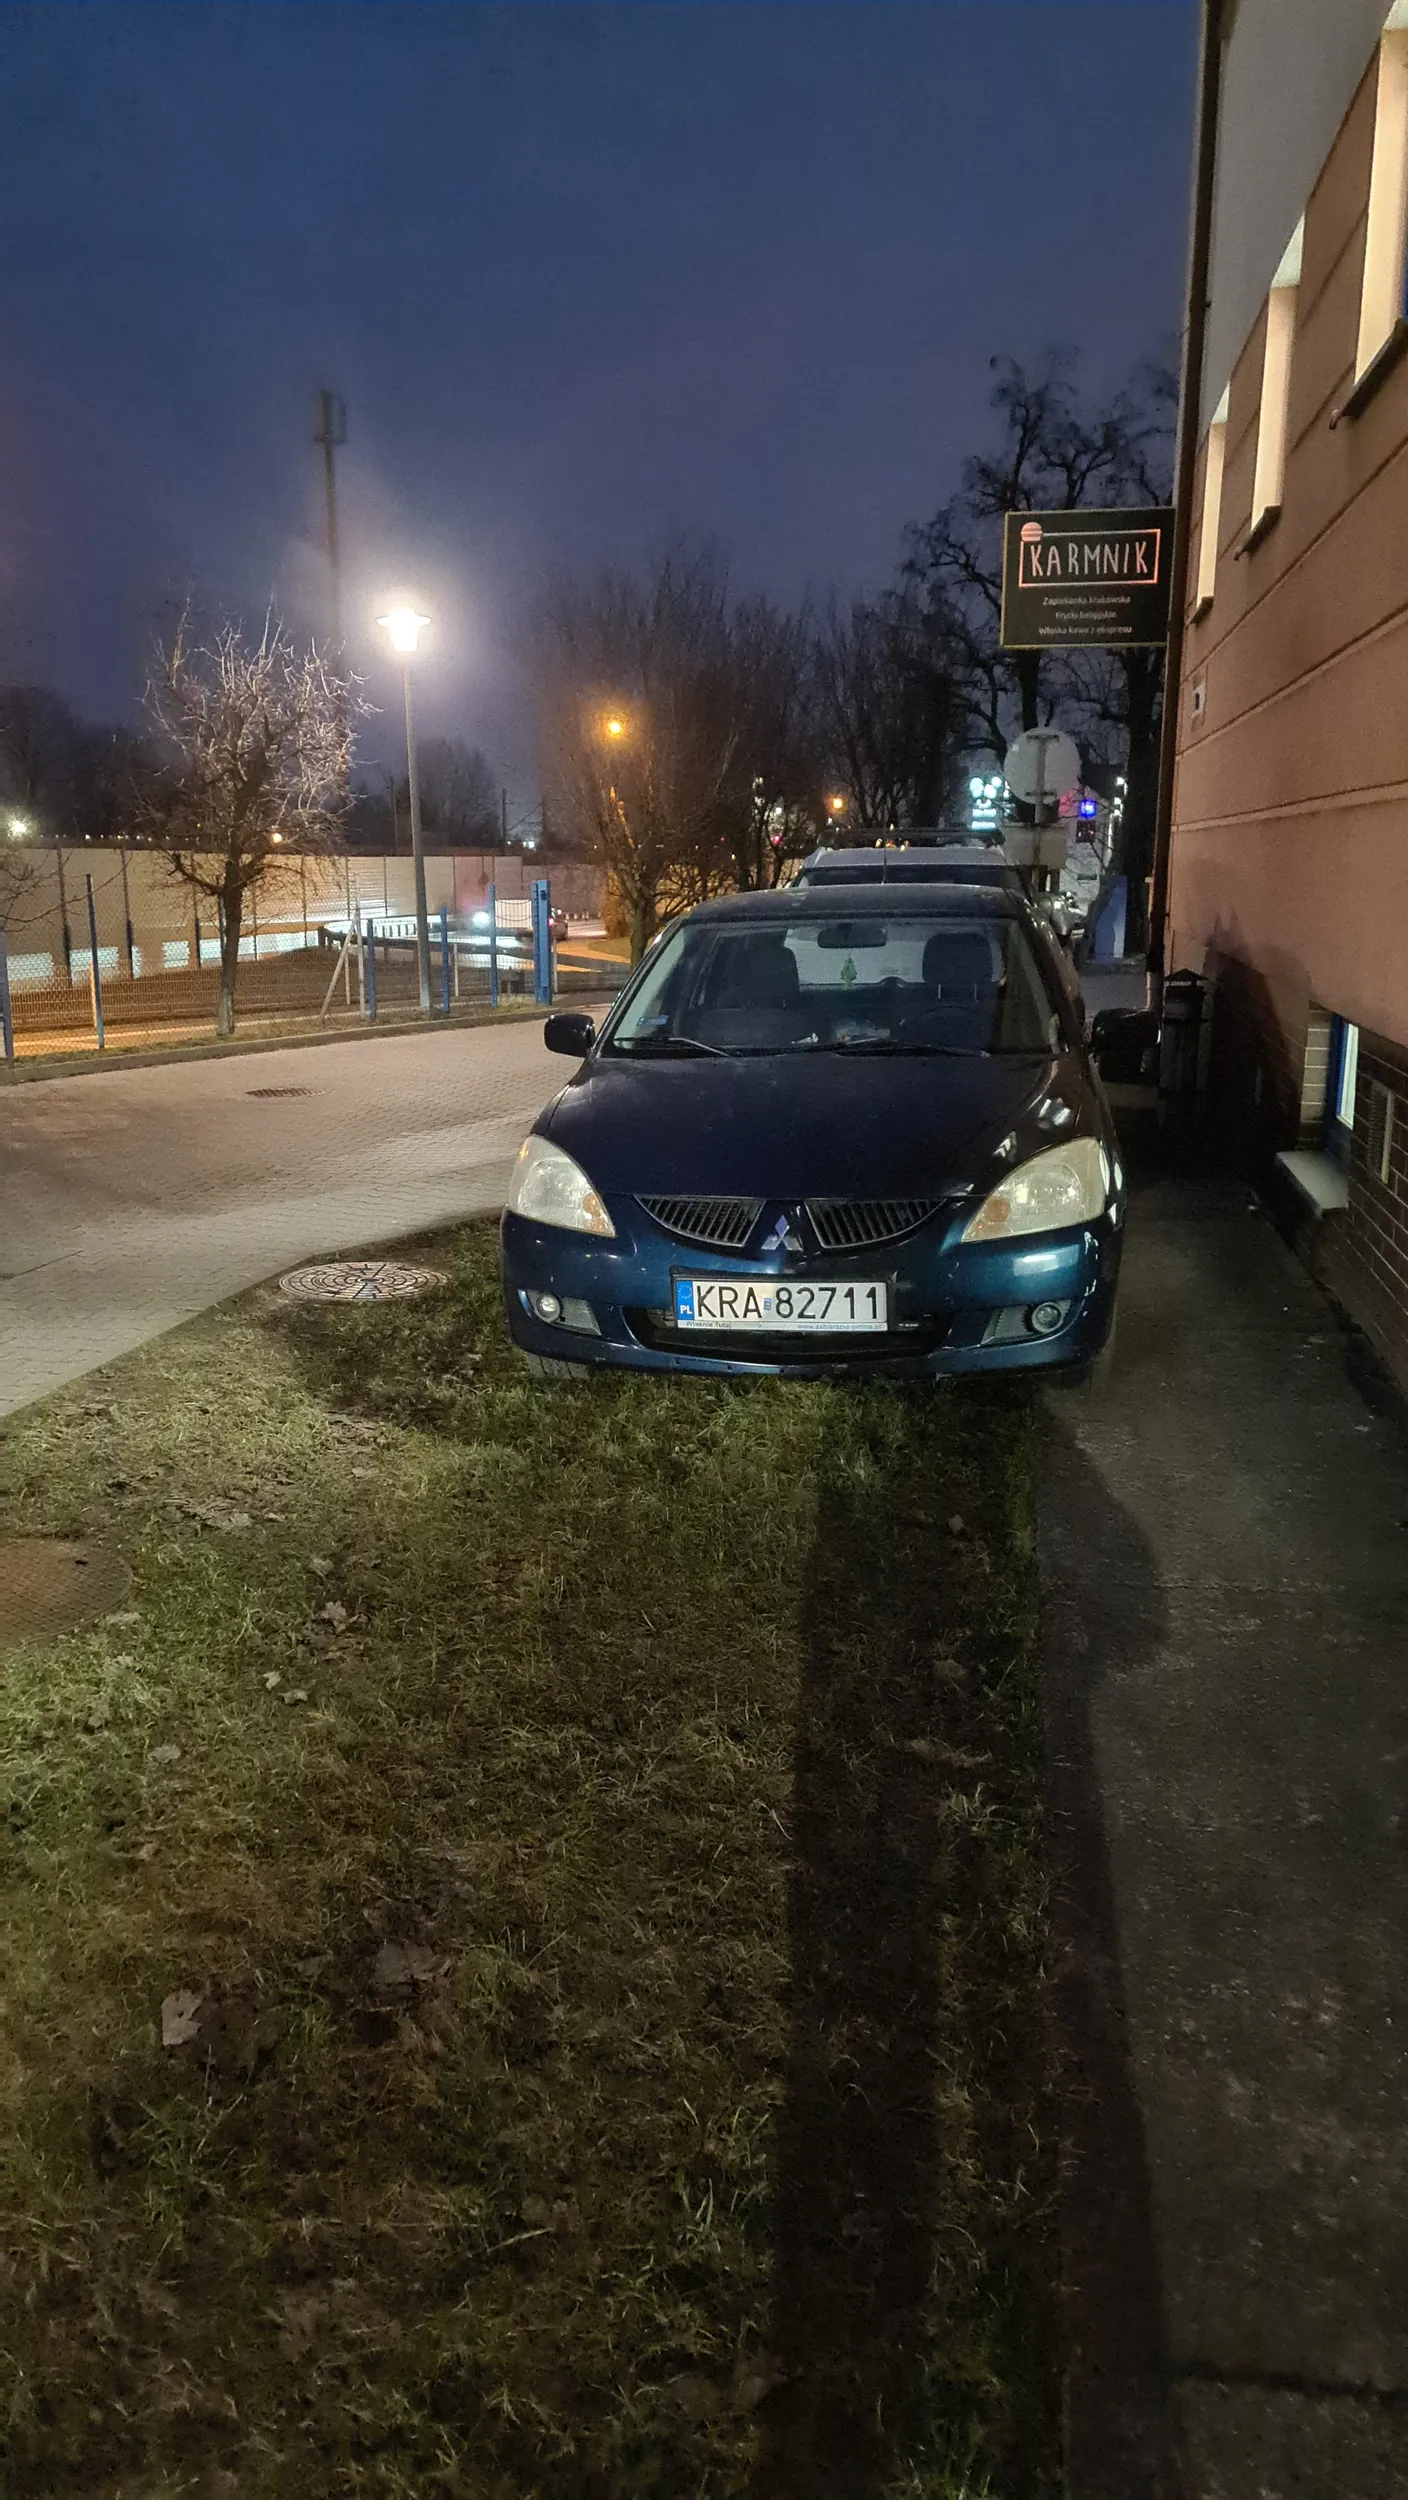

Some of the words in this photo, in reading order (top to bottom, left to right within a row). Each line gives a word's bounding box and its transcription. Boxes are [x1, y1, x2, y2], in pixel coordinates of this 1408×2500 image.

[1030, 541, 1148, 577] KARMNIK
[680, 1305, 693, 1315] PL
[696, 1285, 763, 1319] KRA
[775, 1287, 878, 1319] 82711
